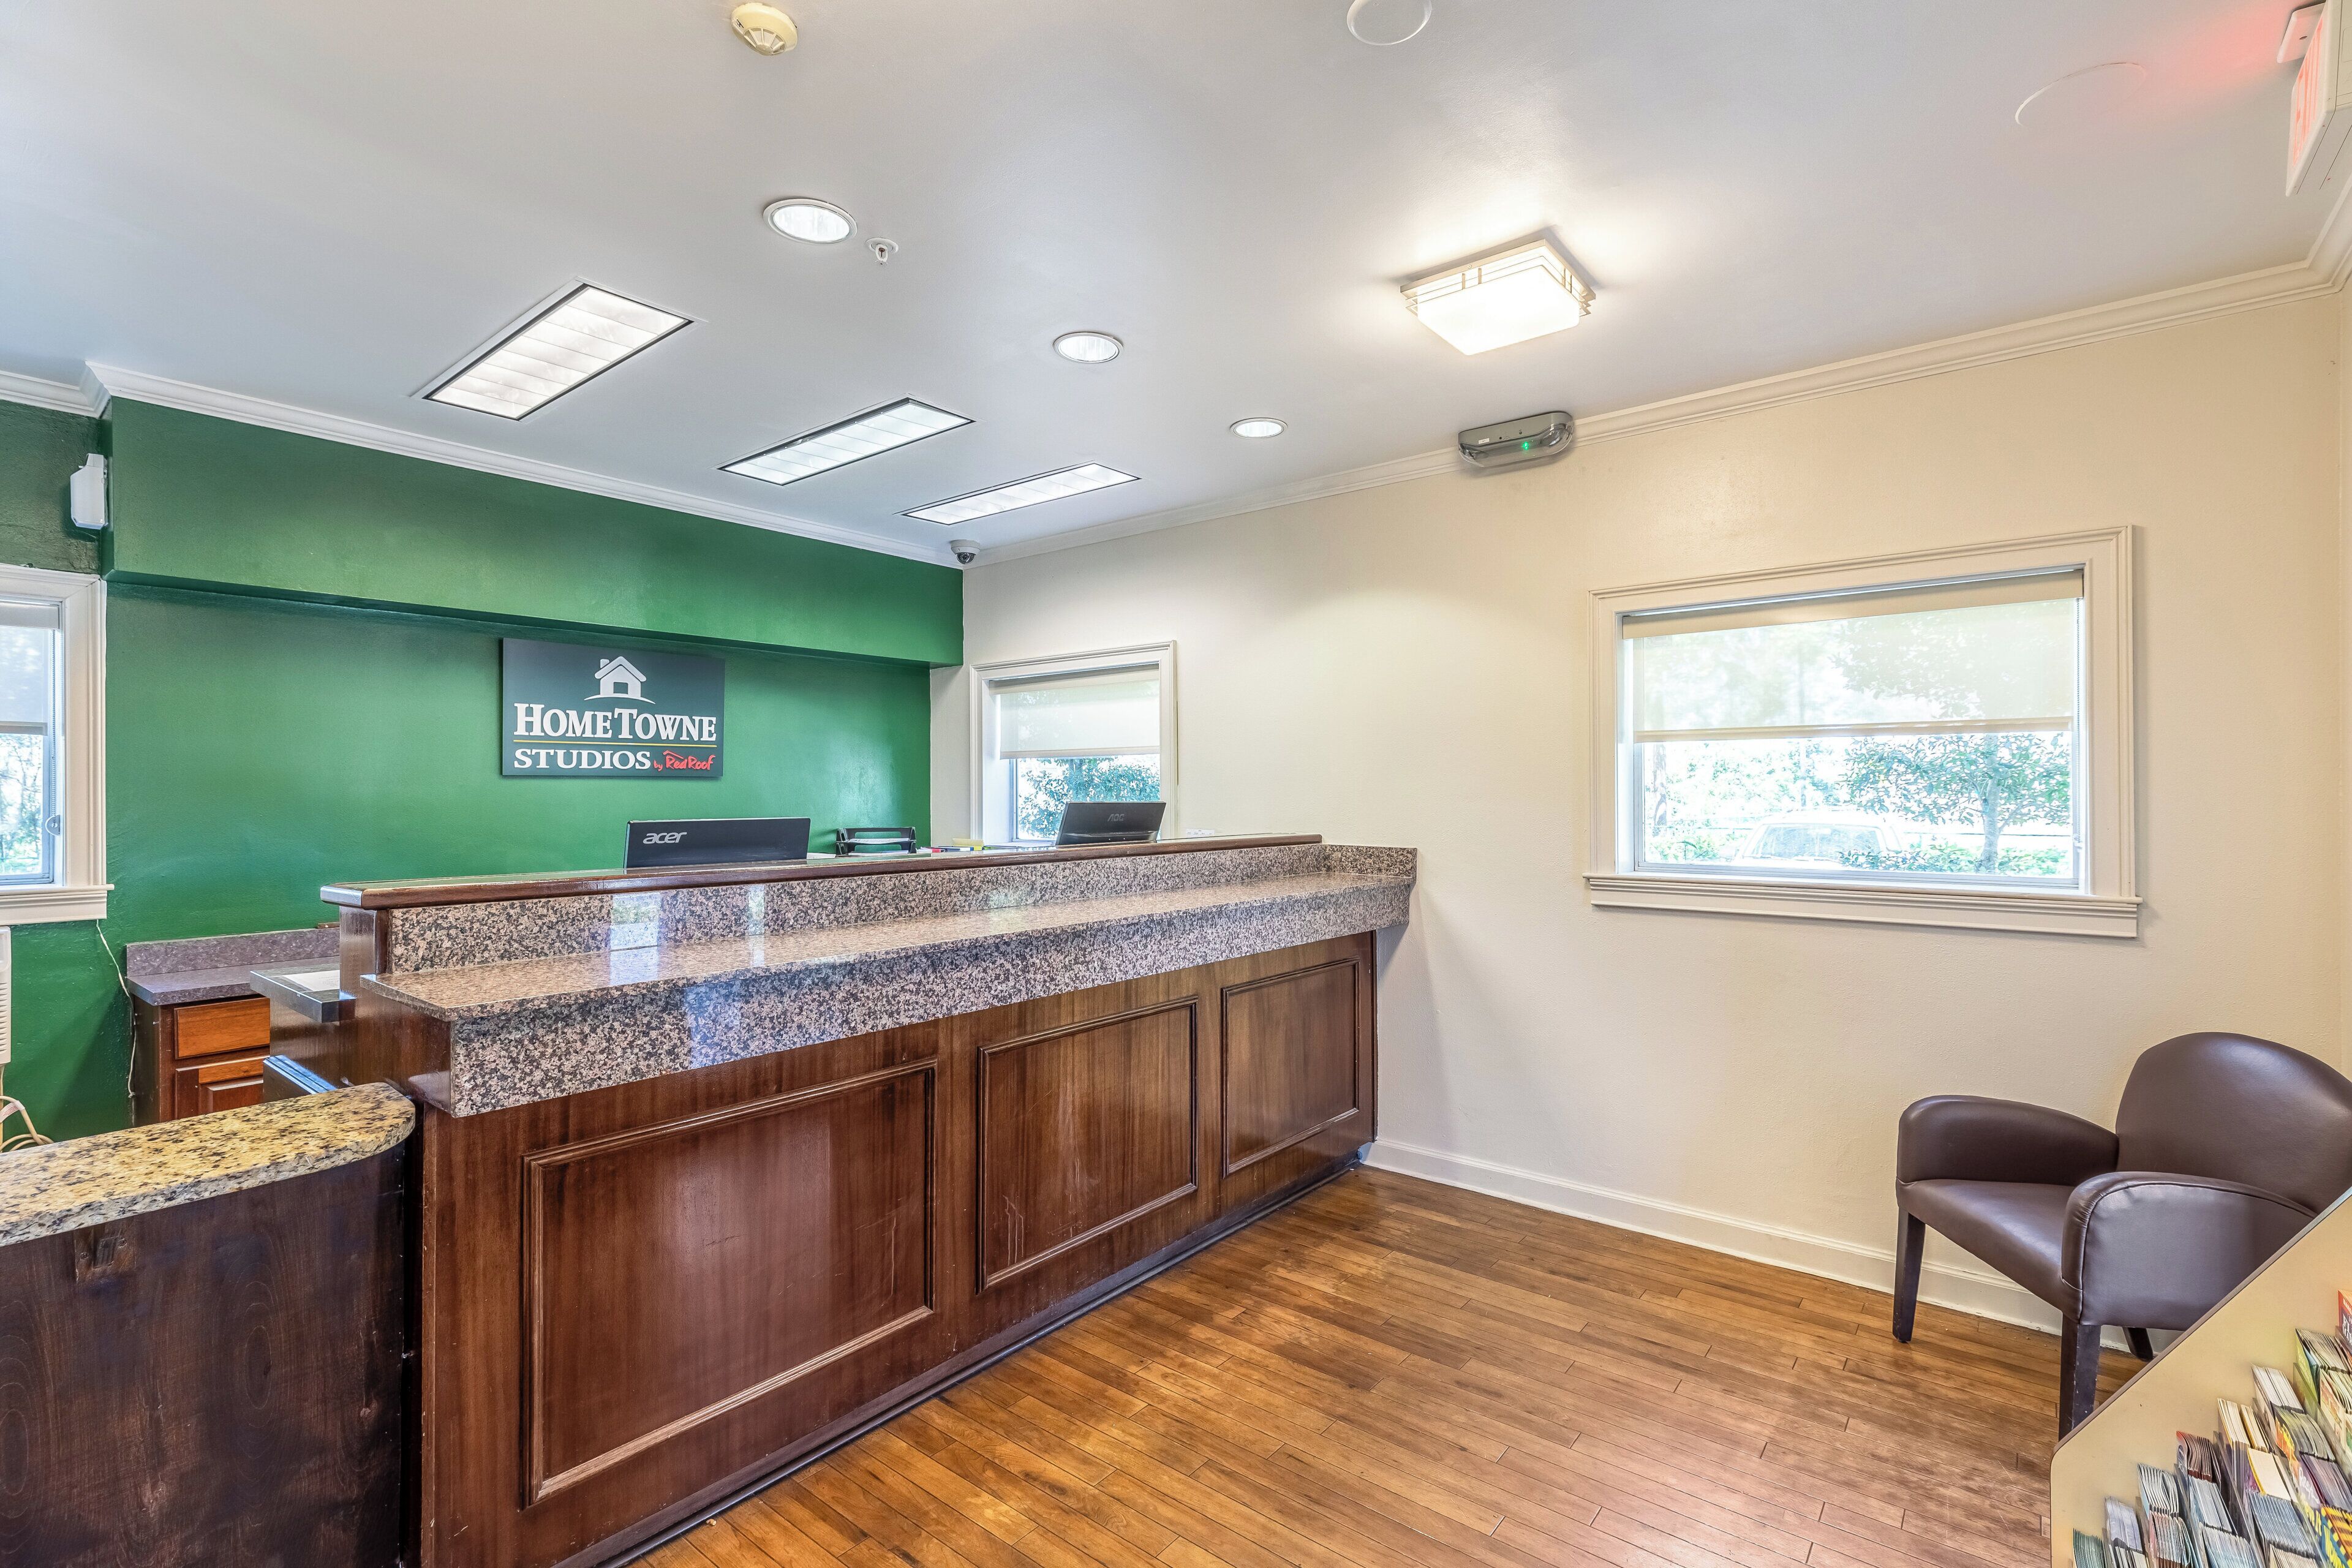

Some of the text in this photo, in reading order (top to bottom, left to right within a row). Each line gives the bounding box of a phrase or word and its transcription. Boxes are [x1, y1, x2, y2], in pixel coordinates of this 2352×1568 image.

[514, 748, 651, 769] STUDIOS
[654, 760, 663, 771] by
[643, 832, 687, 844] acer
